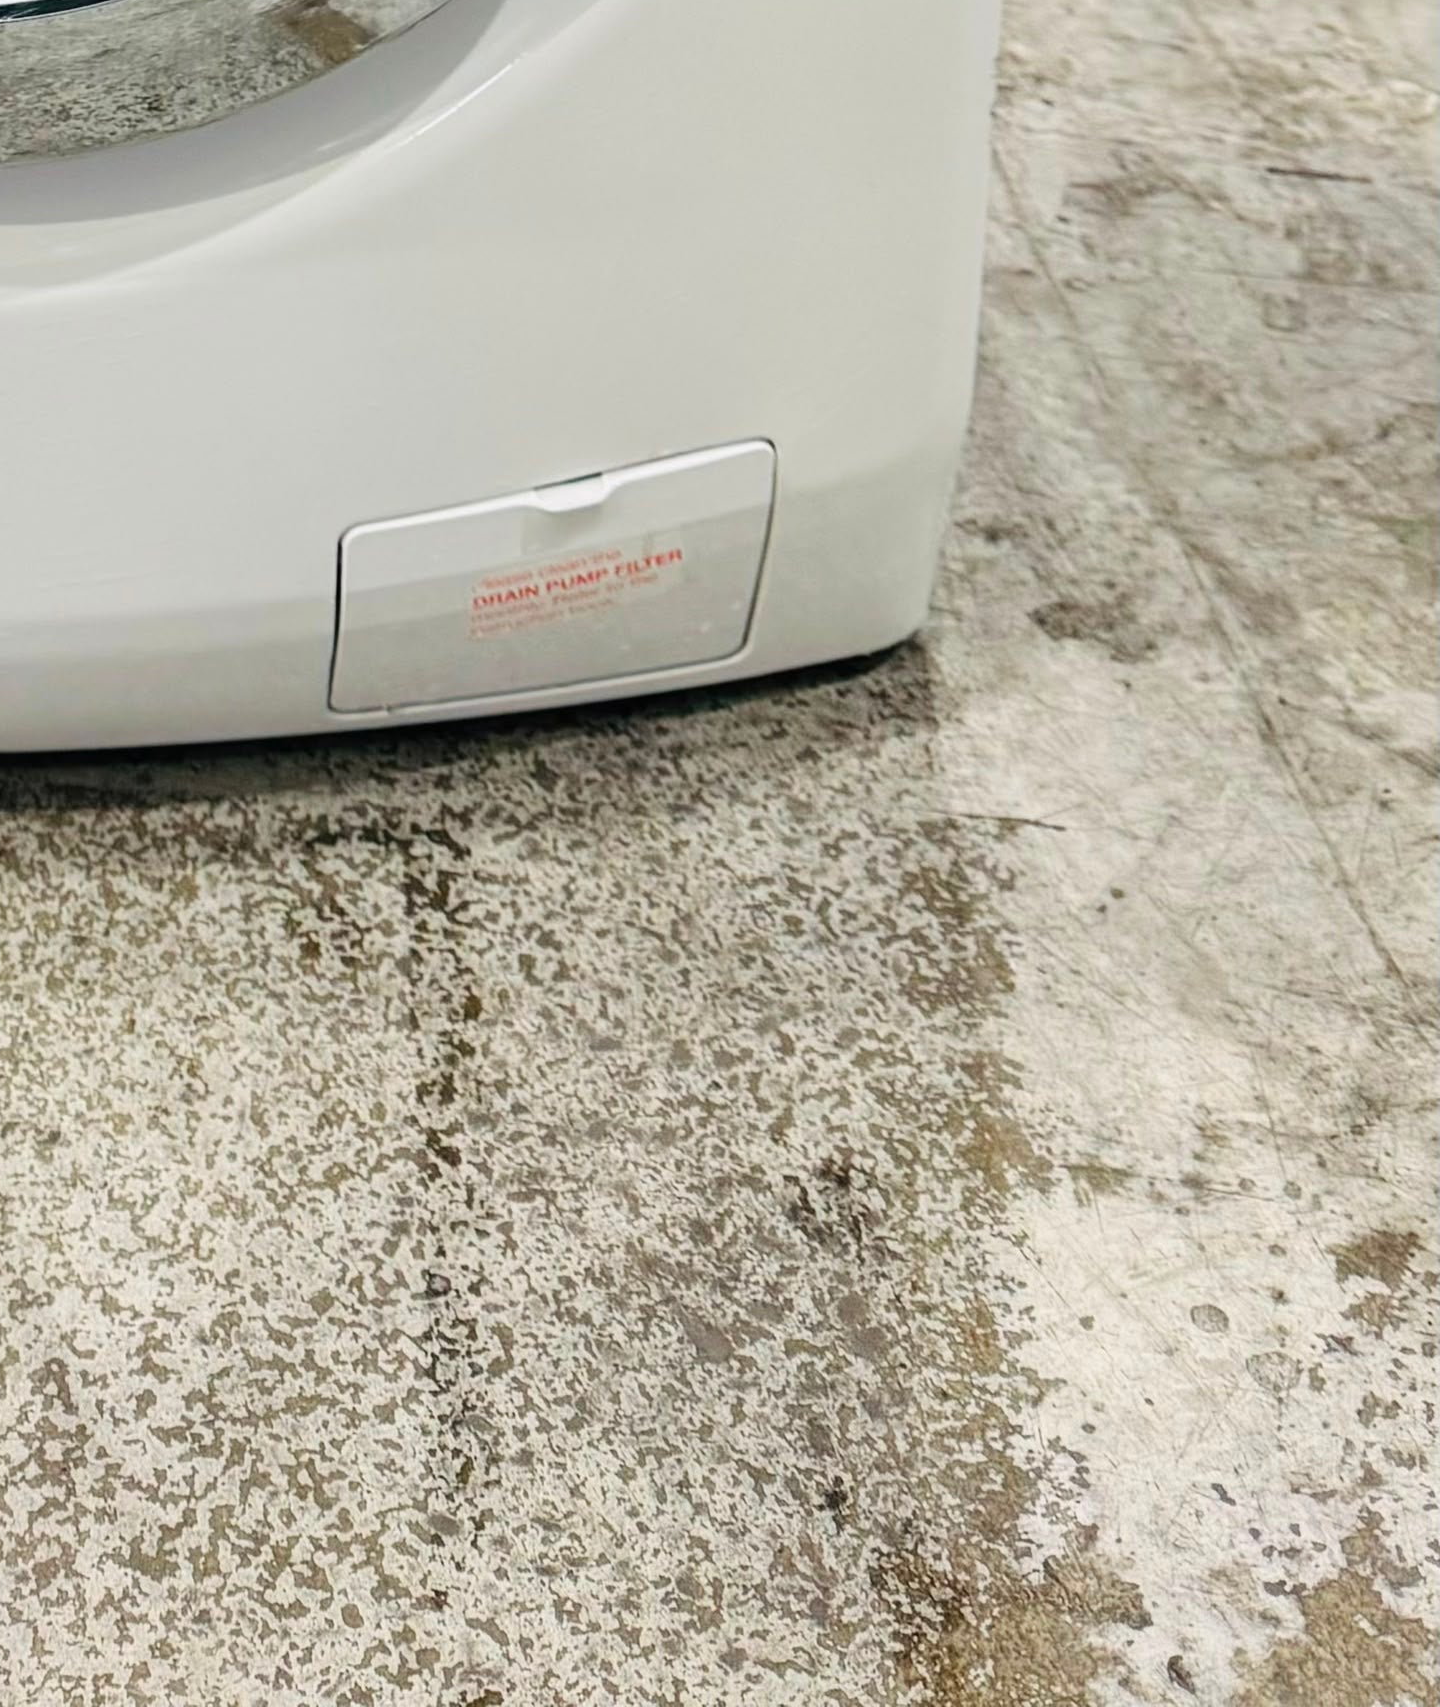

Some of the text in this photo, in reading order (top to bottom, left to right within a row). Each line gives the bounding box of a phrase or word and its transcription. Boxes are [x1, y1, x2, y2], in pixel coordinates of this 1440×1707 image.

[473, 583, 539, 611] DRAIN
[545, 567, 609, 594] PUMP
[614, 548, 684, 577] FILTER
